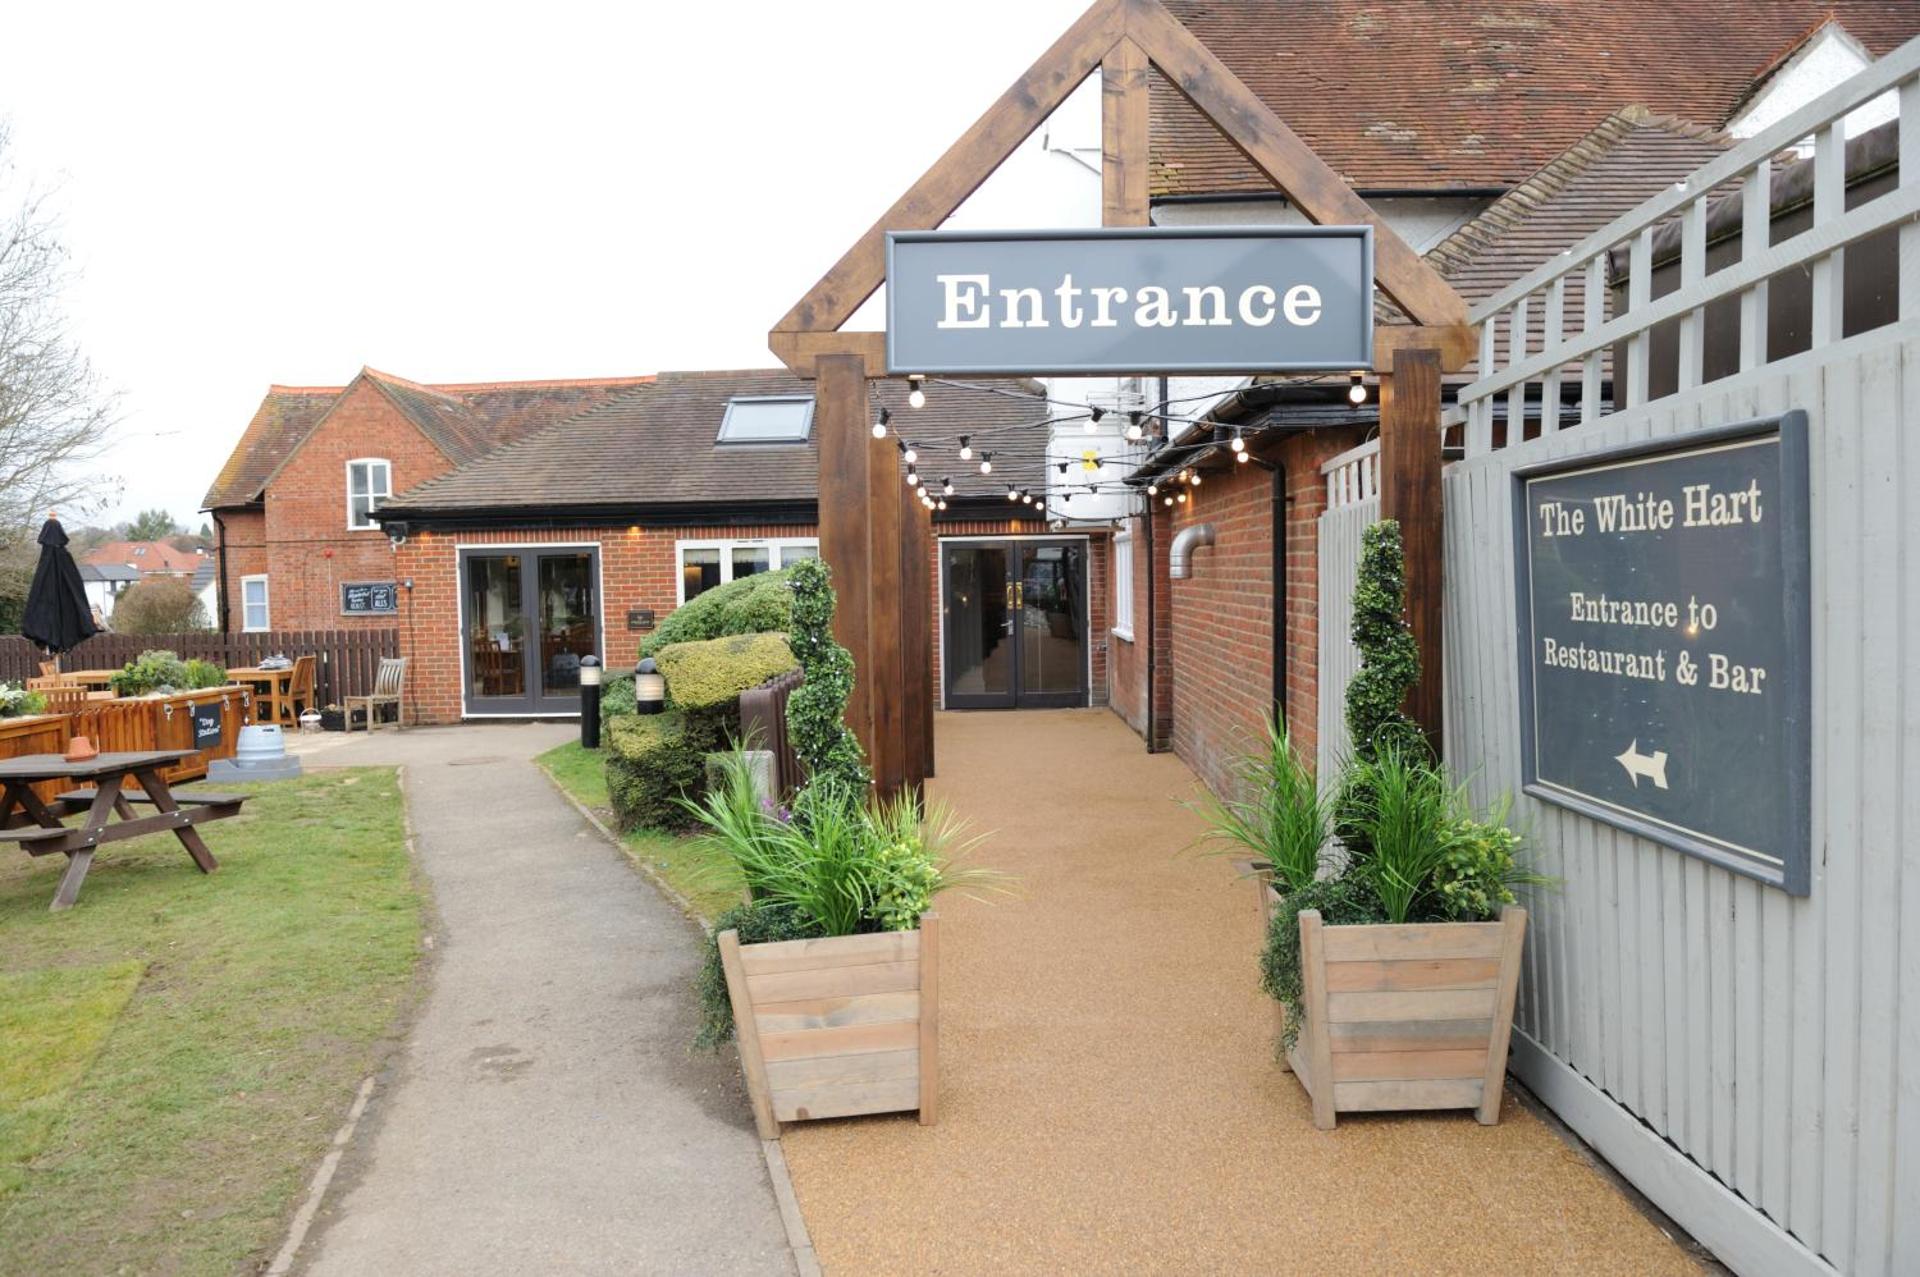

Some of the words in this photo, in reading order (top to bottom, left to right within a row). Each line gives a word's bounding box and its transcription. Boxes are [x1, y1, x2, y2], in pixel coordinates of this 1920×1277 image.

[937, 274, 1322, 328] Entrance
[1540, 503, 1585, 537] The
[1593, 492, 1674, 533] White
[1683, 479, 1763, 527] Hart
[1570, 592, 1678, 628] Entrance
[1687, 596, 1718, 631] to
[1544, 638, 1666, 682] Restaurant
[1676, 651, 1698, 686] &
[1709, 654, 1766, 695] Bar
